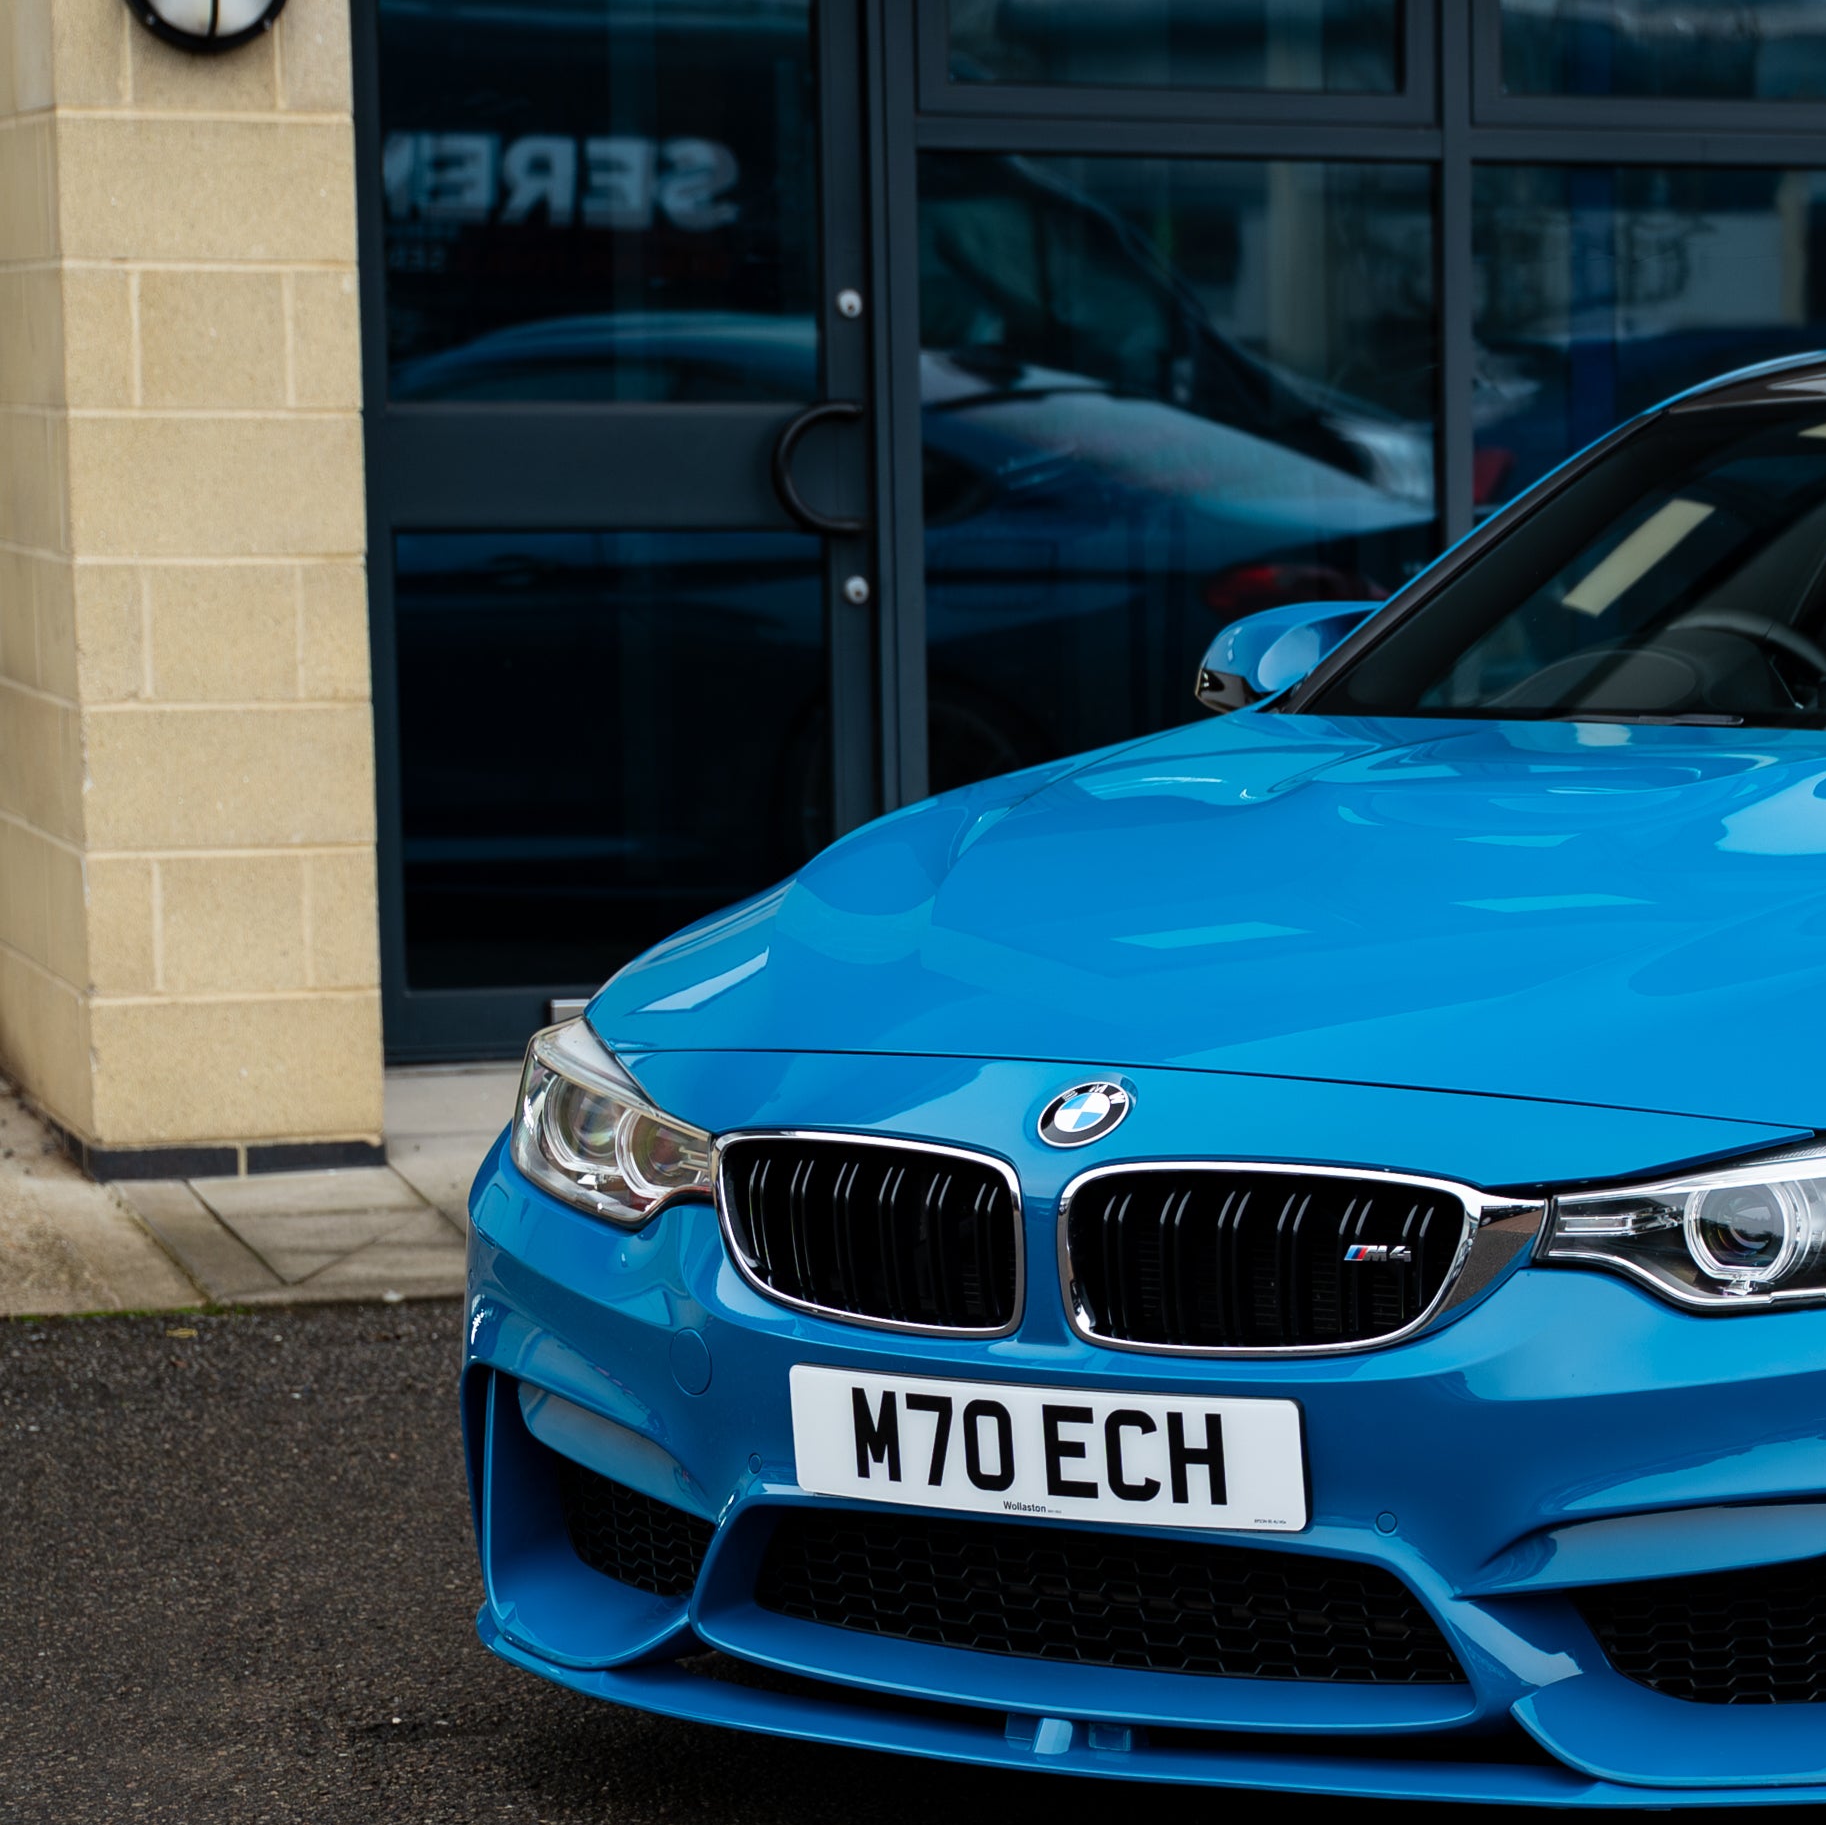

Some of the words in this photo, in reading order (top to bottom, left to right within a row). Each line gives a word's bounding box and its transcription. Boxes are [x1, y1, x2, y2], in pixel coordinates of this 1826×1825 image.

[1062, 1083, 1126, 1105] BMW
[1361, 1245, 1411, 1262] M4
[851, 1386, 1016, 1492] M70
[1042, 1403, 1228, 1506] ECH
[1003, 1501, 1046, 1513] Wollaston
